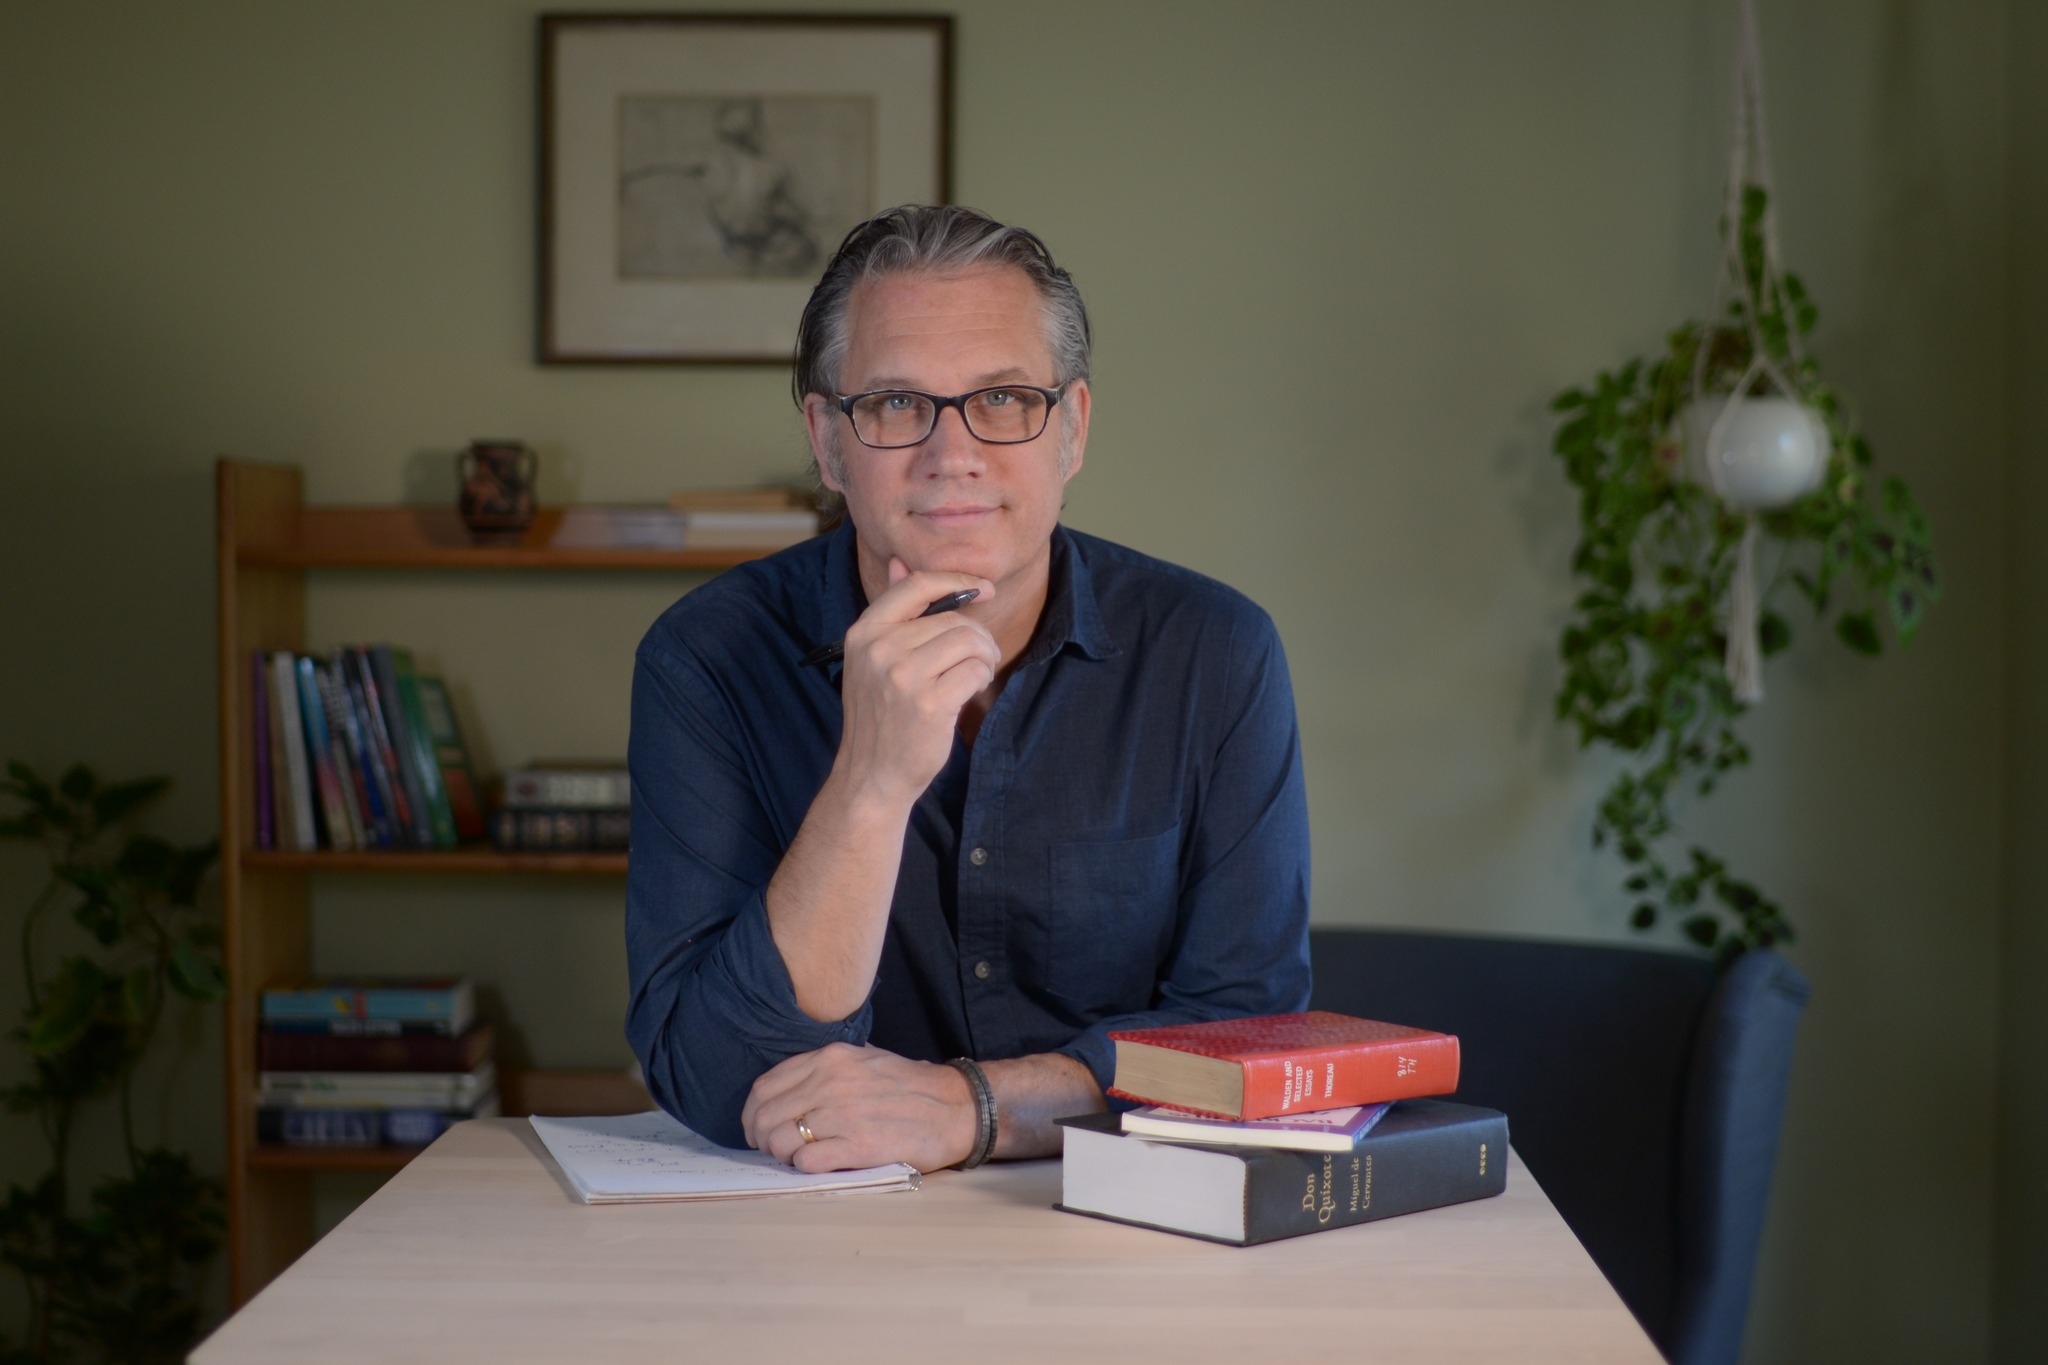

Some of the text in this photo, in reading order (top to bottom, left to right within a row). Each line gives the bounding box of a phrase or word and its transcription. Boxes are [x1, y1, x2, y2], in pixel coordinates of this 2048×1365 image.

[1282, 1061, 1292, 1110] WALDEN AND
[1293, 1066, 1303, 1102] SELECTED
[1304, 1069, 1314, 1096] ESSAYS
[1325, 1063, 1334, 1098] THOREAU
[1398, 1056, 1408, 1077] 814
[1303, 1173, 1315, 1211] Don
[1318, 1153, 1336, 1223] Quixote
[1350, 1157, 1360, 1212] Miguel de
[1363, 1154, 1372, 1209] Cervantes
